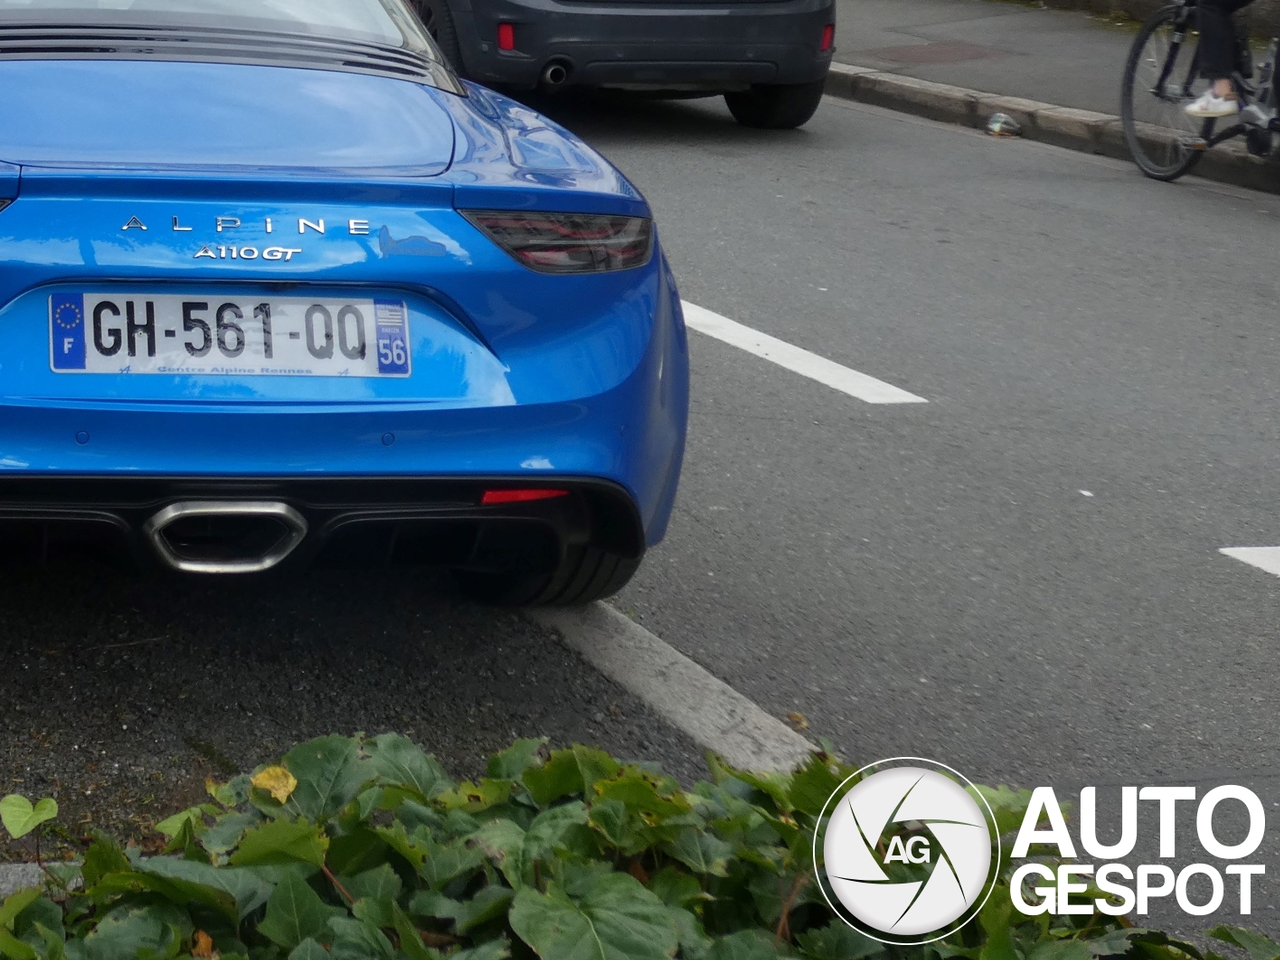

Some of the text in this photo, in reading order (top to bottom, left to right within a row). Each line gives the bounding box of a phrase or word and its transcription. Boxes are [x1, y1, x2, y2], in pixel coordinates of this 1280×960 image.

[121, 215, 370, 236] ALPINE
[92, 300, 367, 361] GH-561-QQ
[63, 337, 74, 354] F
[378, 339, 406, 365] 56
[156, 366, 205, 374] Centre
[210, 367, 255, 375] Alpine
